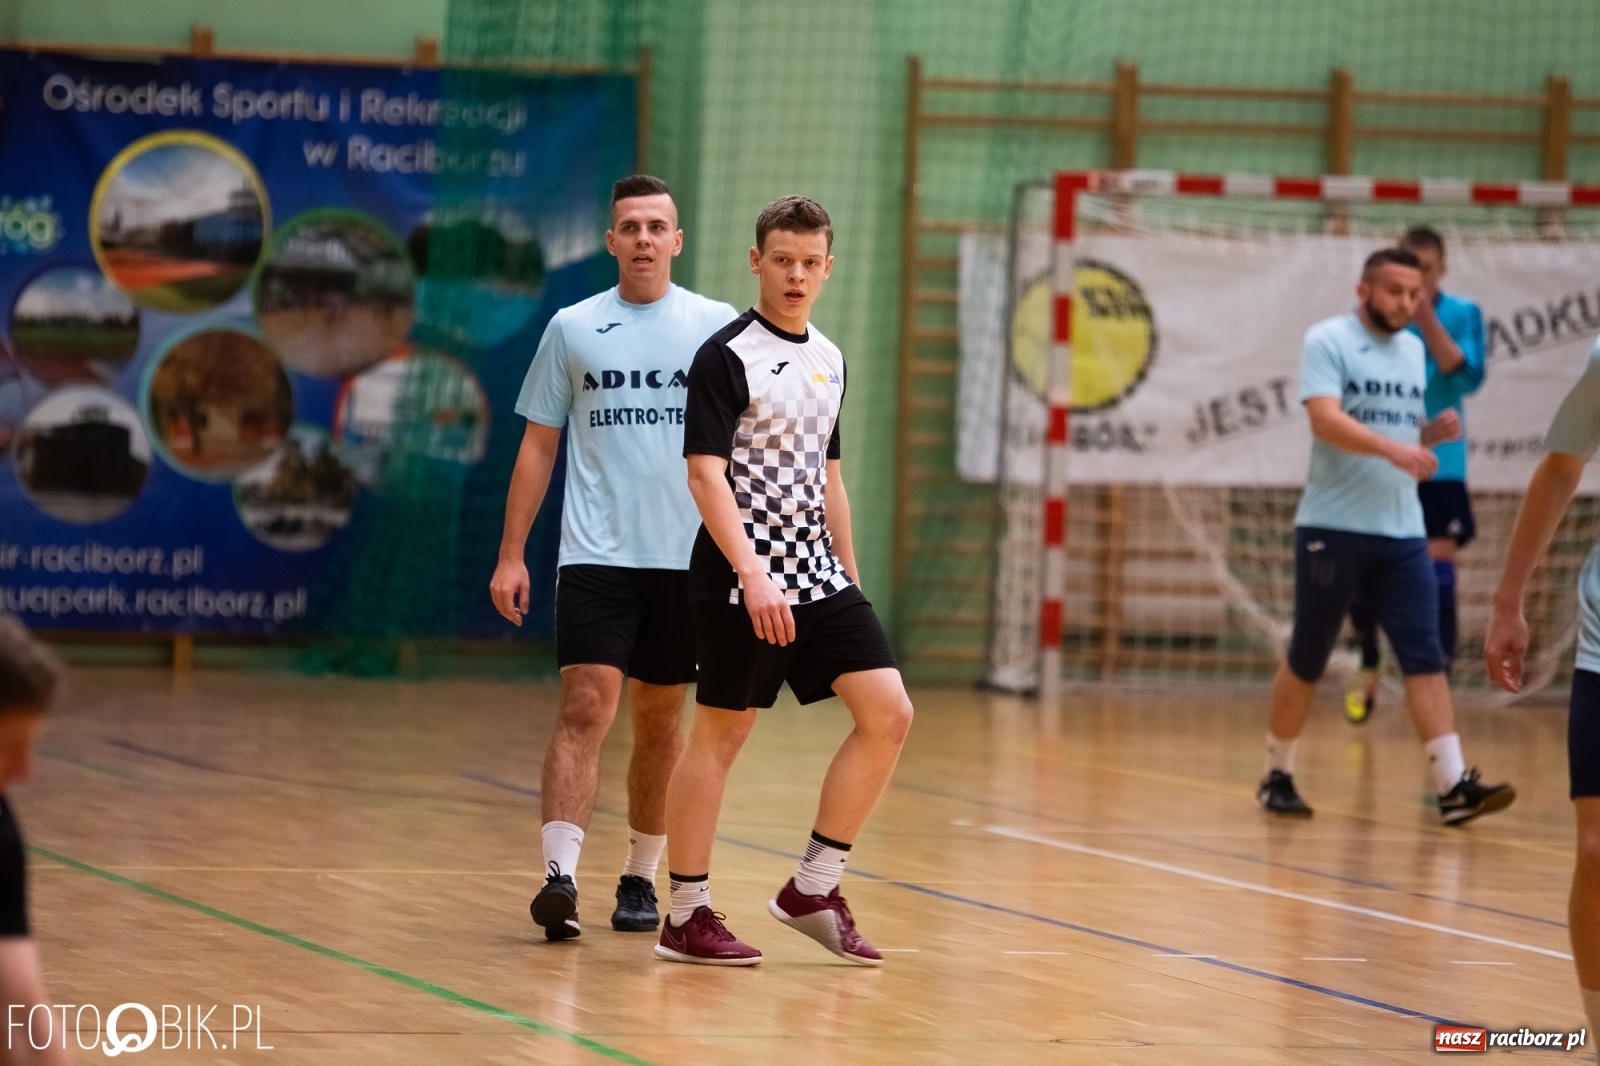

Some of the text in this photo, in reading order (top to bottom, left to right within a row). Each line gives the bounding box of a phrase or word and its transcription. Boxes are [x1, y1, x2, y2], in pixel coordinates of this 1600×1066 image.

[43, 73, 527, 136] Ośrodek Sportu i Rekreacji
[304, 136, 526, 177] w Raciborzu
[582, 368, 688, 393] ADICA
[1344, 379, 1421, 399] ADICA
[589, 407, 686, 428] ELEKTRO-TE
[1185, 376, 1290, 446] JEST
